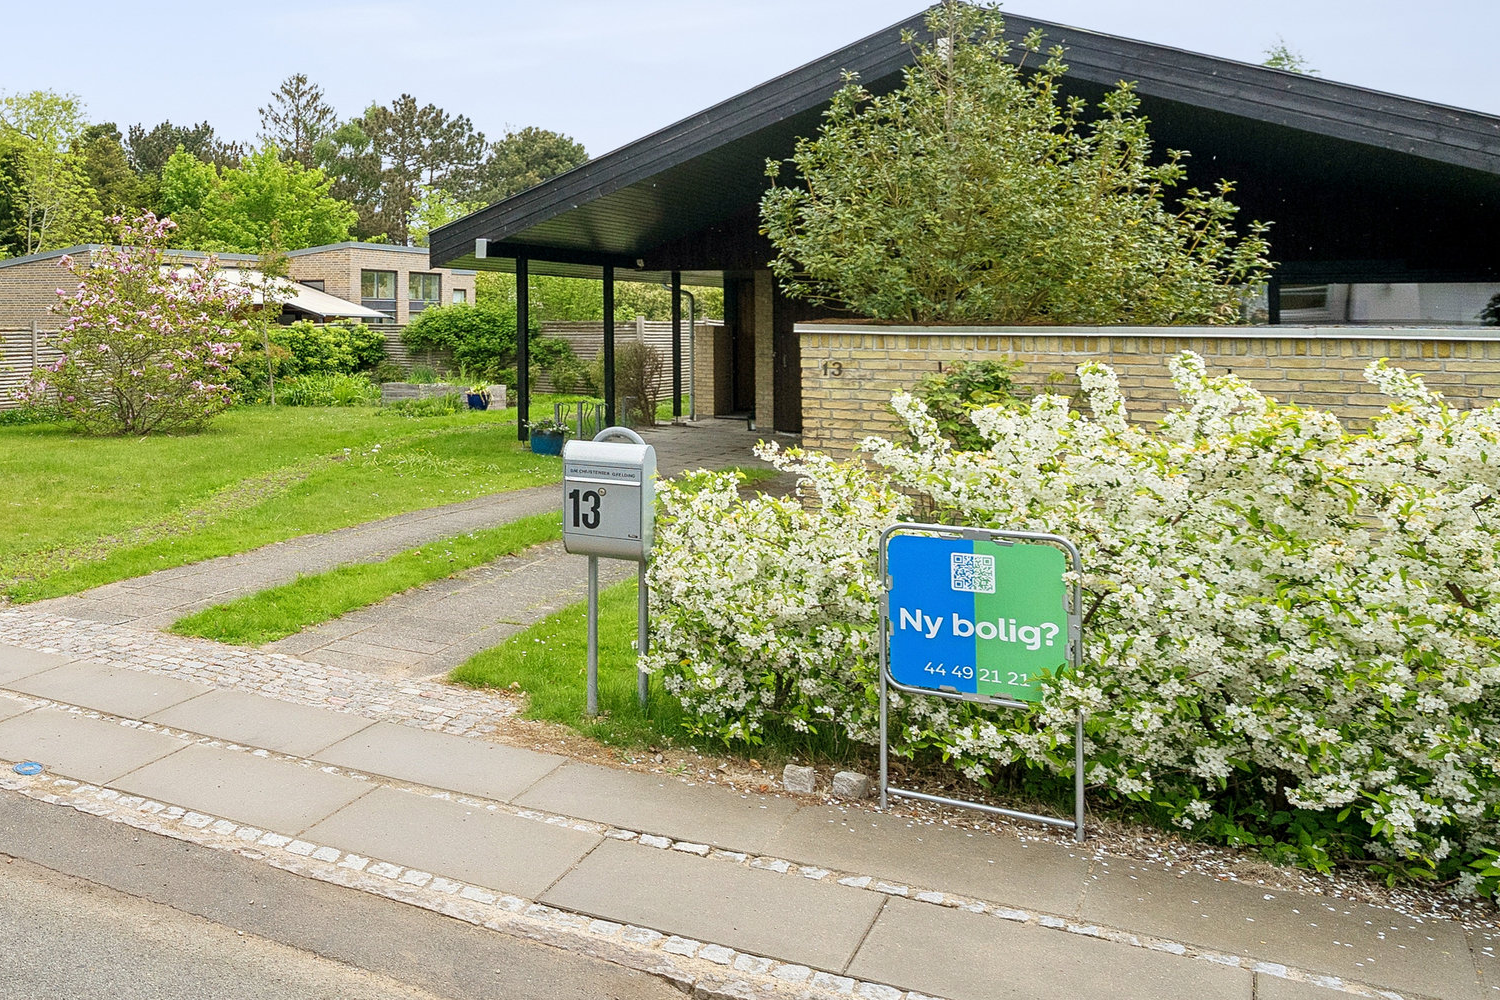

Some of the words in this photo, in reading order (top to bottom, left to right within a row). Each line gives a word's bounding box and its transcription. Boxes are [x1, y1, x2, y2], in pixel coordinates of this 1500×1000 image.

[822, 361, 843, 376] 13
[568, 488, 601, 530] 13
[900, 607, 943, 639] Ny
[952, 613, 1059, 651] bolig?
[924, 661, 947, 677] 44
[951, 665, 974, 680] 49
[979, 668, 1002, 684] 21
[1007, 671, 1031, 688] 21
